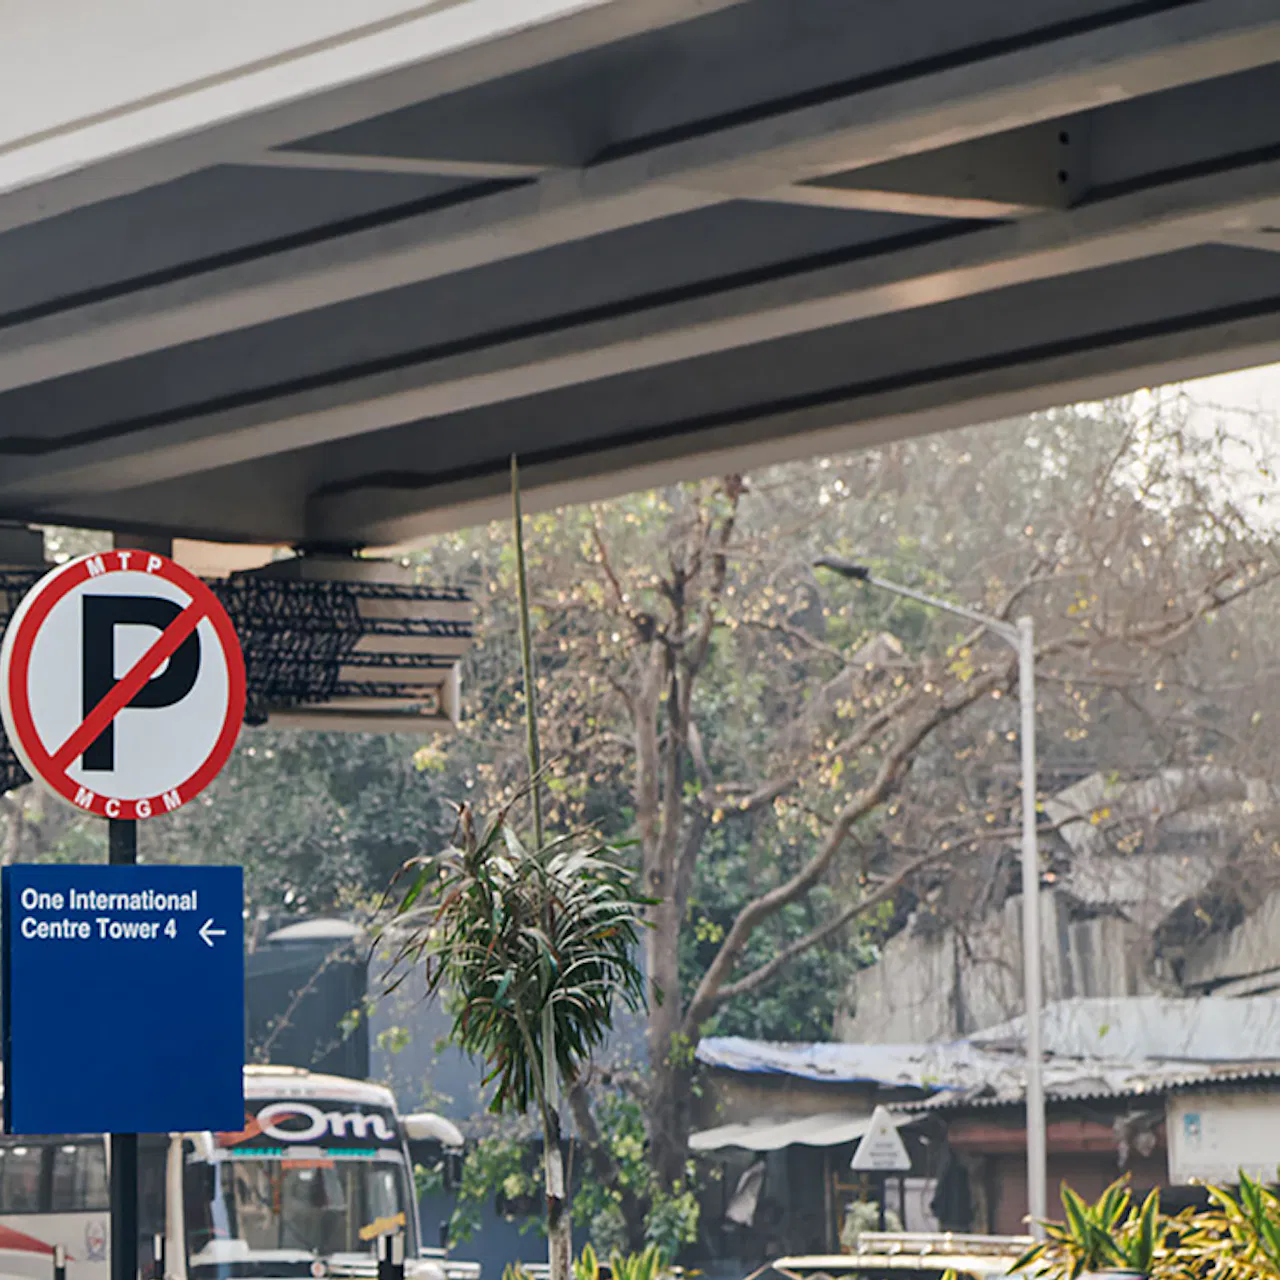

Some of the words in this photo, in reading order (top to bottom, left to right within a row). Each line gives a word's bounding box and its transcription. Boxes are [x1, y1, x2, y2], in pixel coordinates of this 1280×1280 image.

[82, 594, 201, 771] P
[20, 888, 65, 910] One
[69, 888, 198, 911] International
[20, 916, 91, 939] Centre
[95, 917, 160, 939] Tower
[164, 917, 178, 939] 4
[256, 1102, 395, 1141] Om
